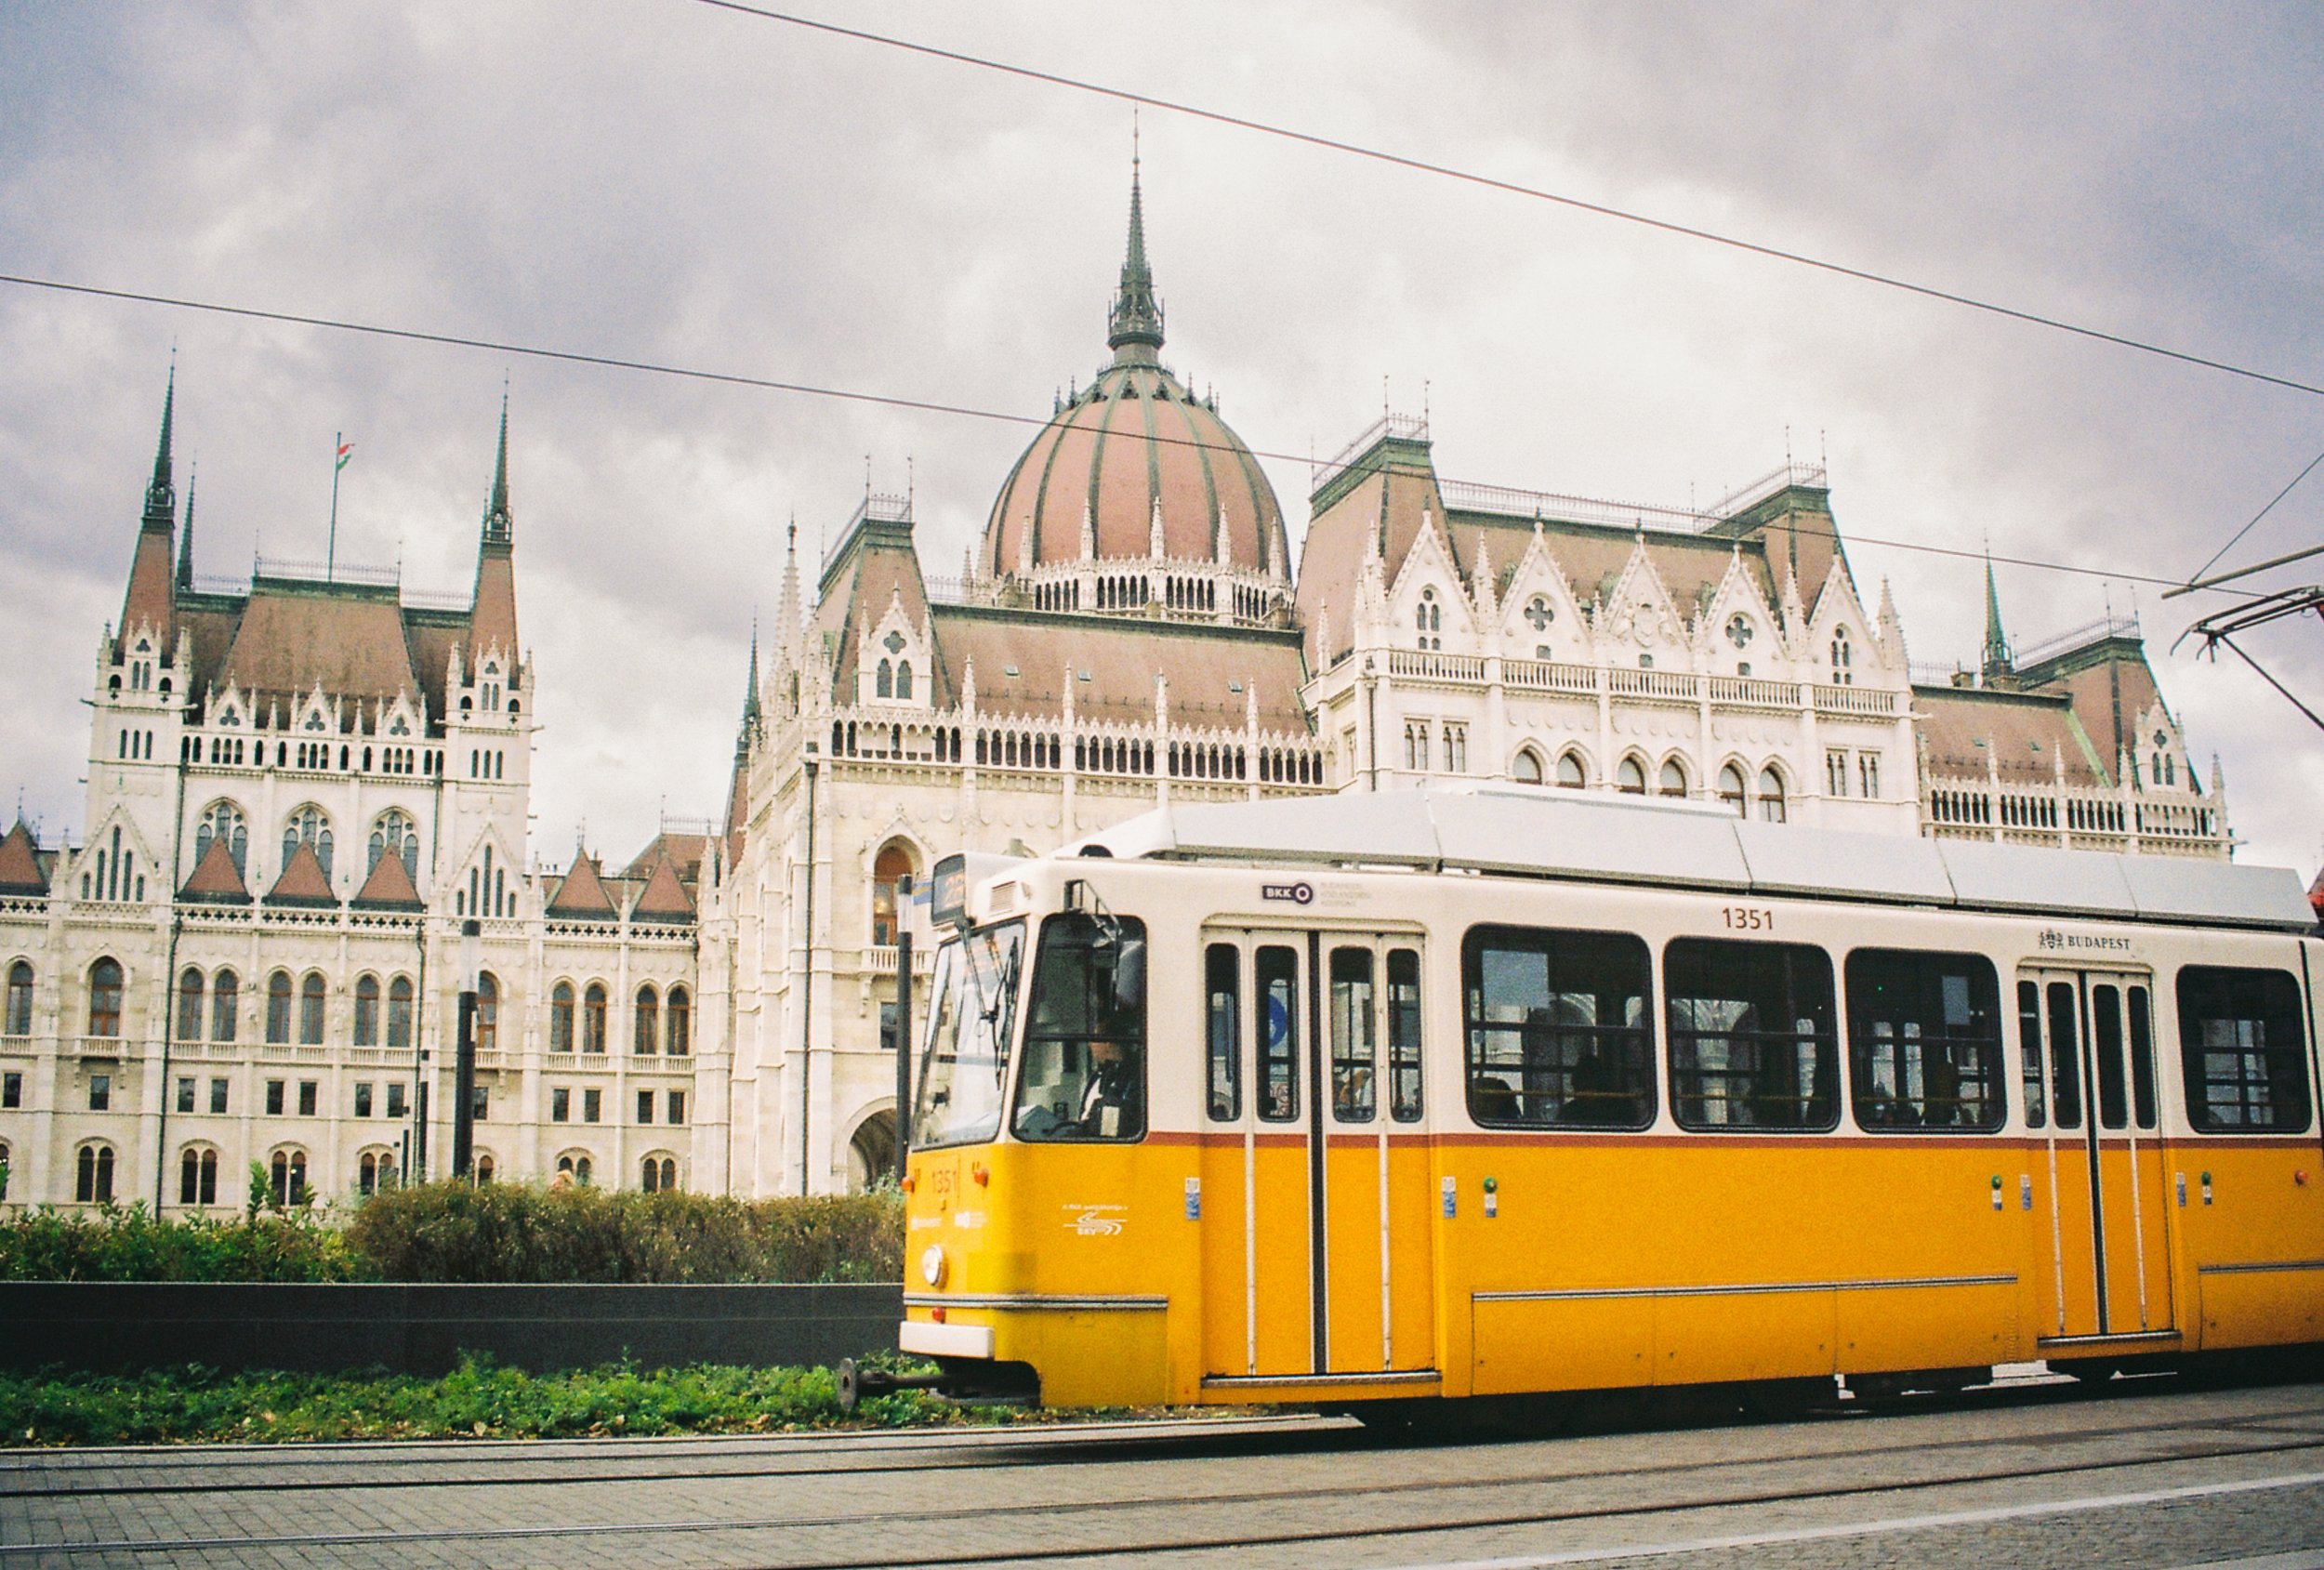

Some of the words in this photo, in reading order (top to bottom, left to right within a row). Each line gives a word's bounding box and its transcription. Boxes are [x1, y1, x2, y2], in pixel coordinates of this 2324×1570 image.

[1266, 888, 1291, 899] BKK
[1723, 907, 1772, 930] 1351
[2067, 935, 2130, 949] BUDAPEST
[931, 1169, 957, 1194] 1351
